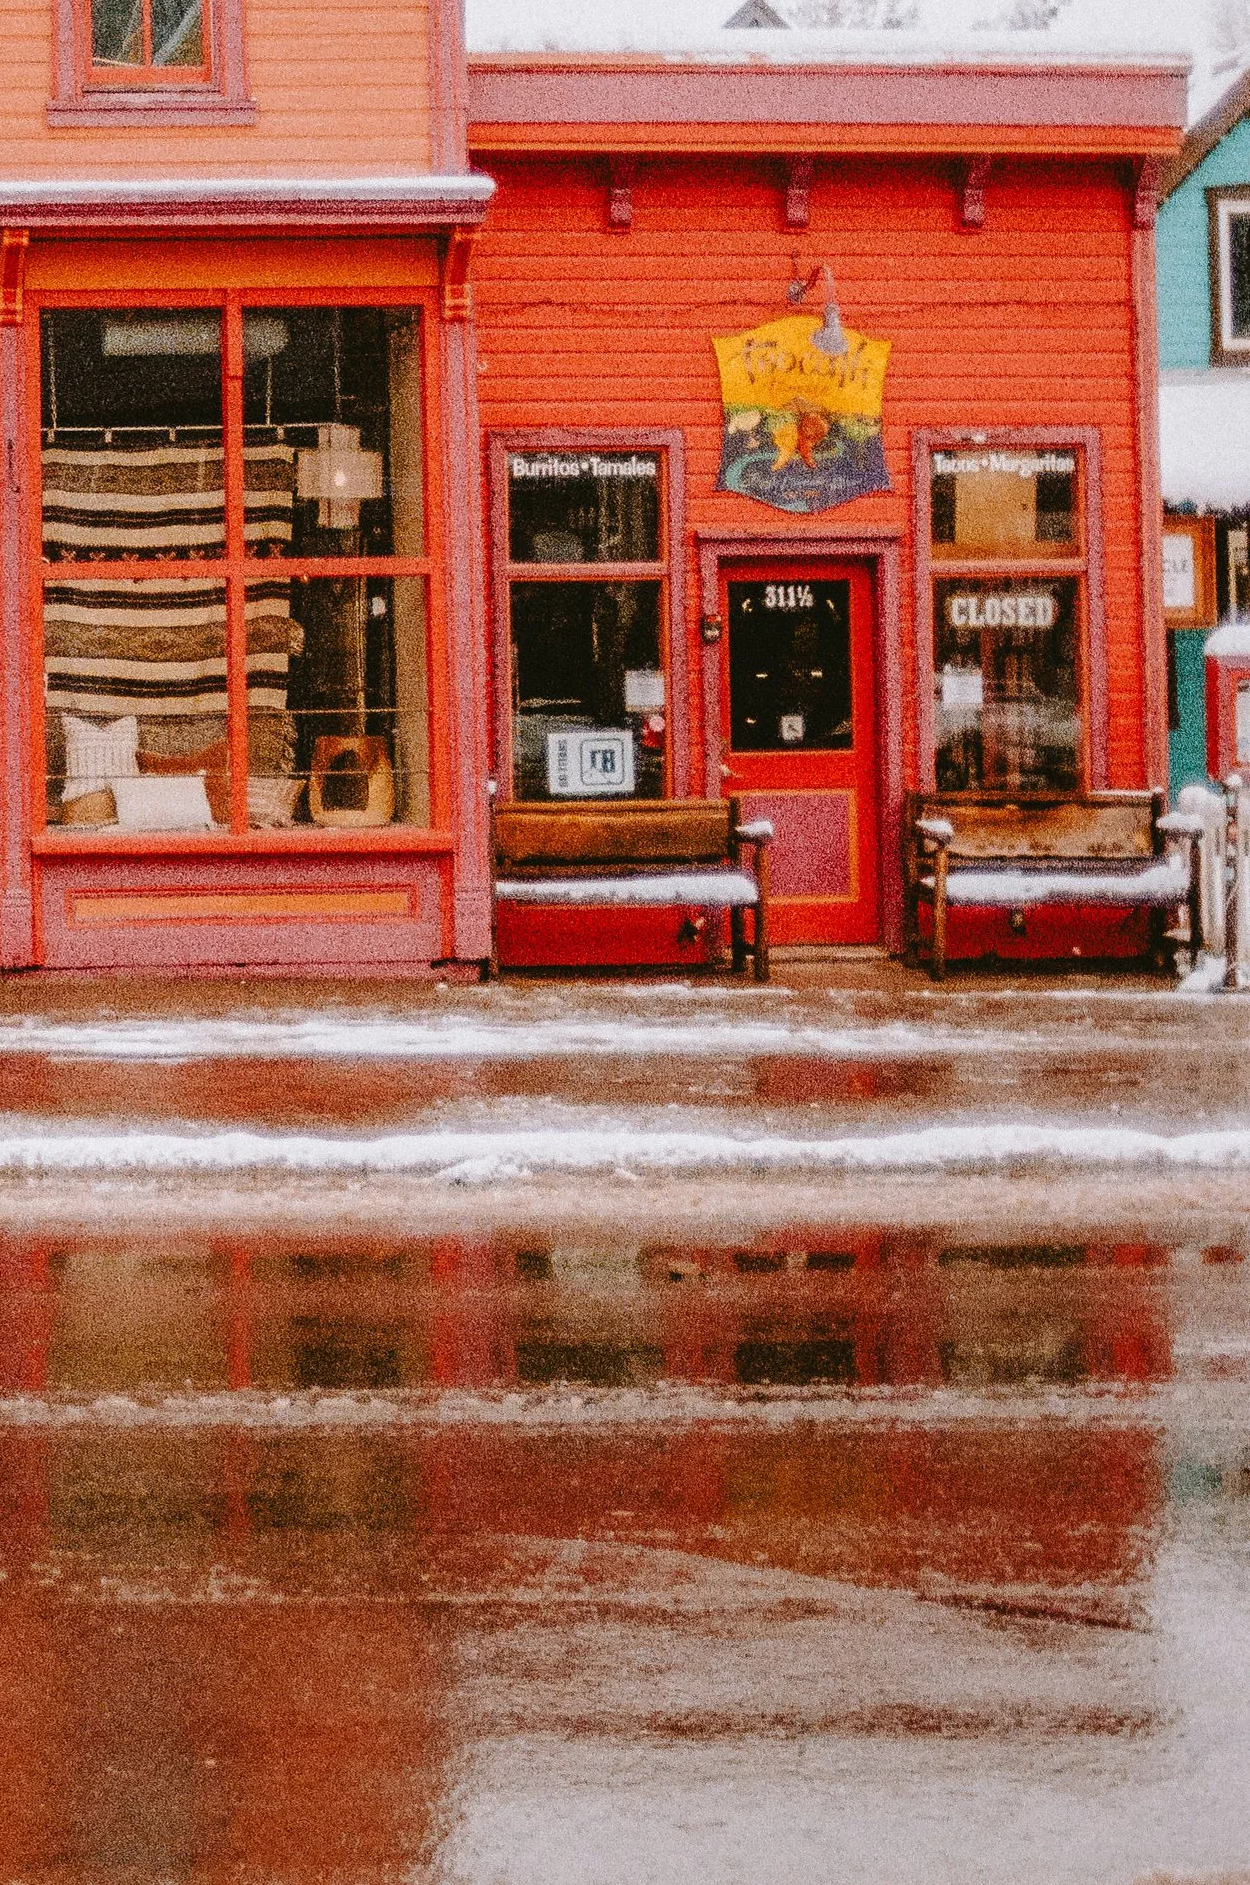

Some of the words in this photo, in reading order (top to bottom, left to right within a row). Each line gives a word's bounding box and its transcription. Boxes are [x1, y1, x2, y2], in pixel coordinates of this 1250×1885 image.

[512, 457, 580, 477] Burritos
[590, 456, 656, 477] Tamales
[933, 454, 979, 473] Tacos
[950, 596, 1055, 627] CLOSED
